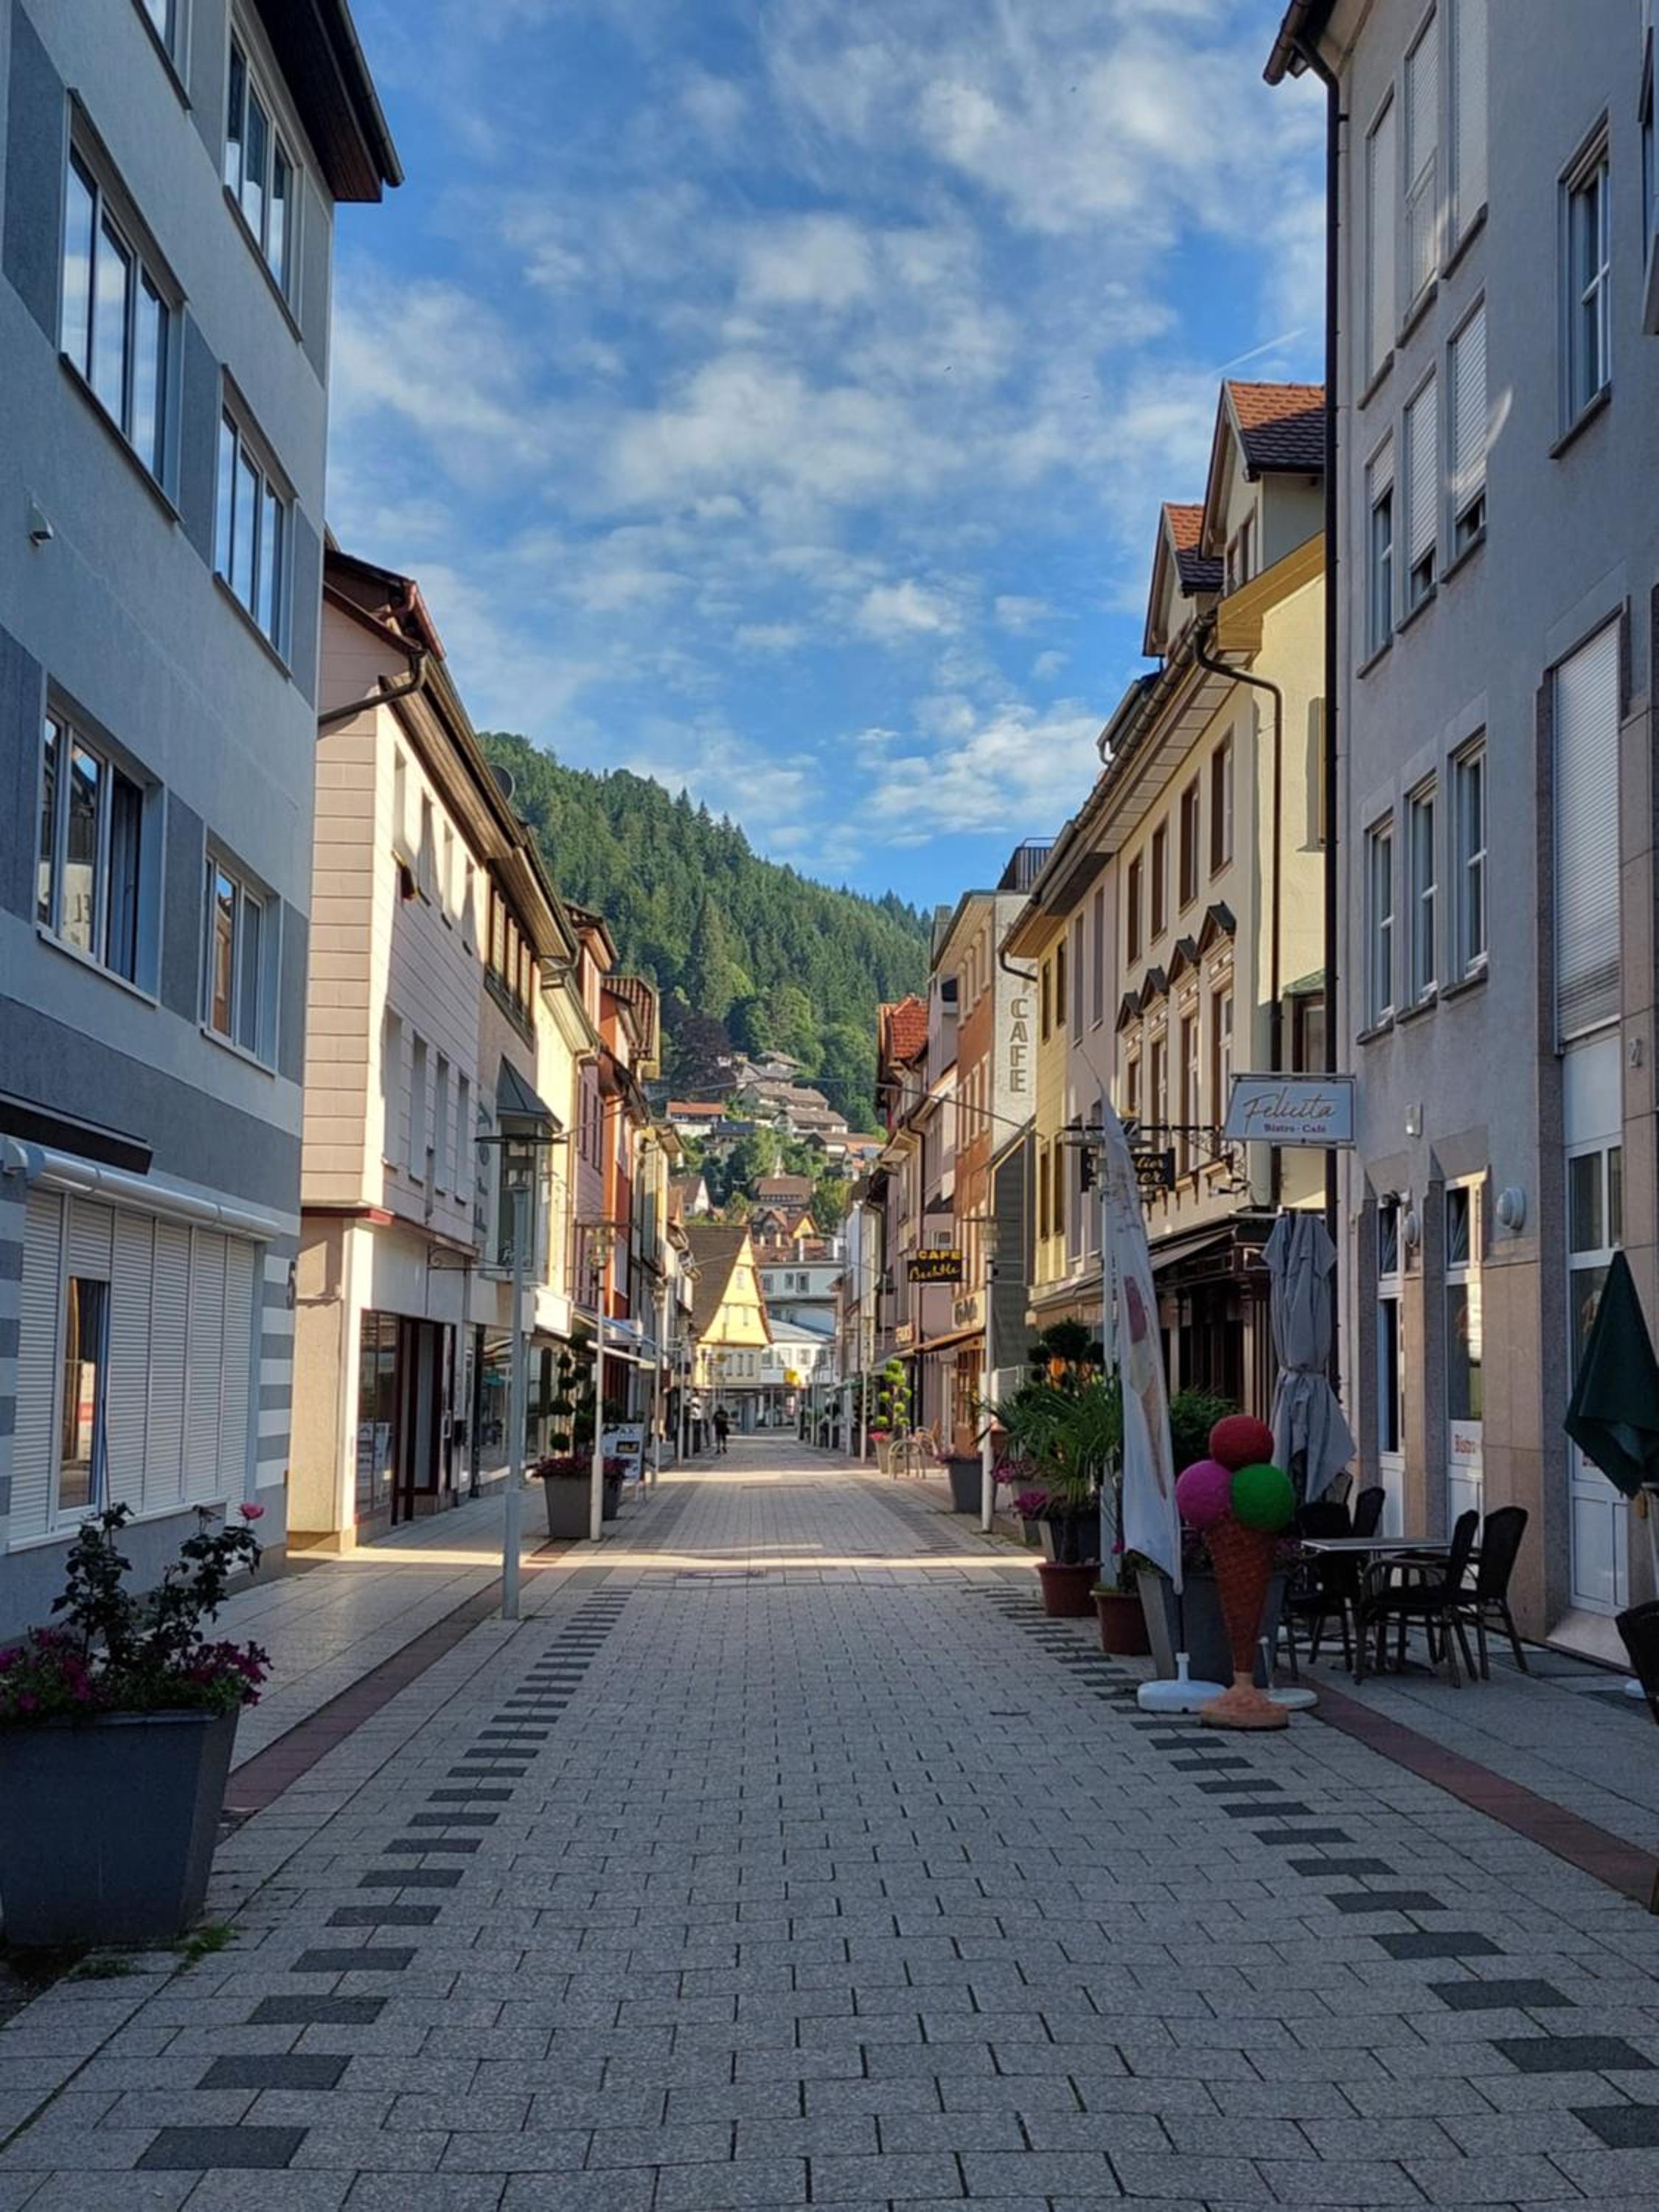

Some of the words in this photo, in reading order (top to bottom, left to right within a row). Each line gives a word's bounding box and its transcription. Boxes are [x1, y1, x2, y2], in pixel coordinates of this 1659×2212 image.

[1009, 998, 1029, 1093] CAFE
[1264, 1123, 1295, 1133] Bistro
[919, 1251, 961, 1260] CAFE
